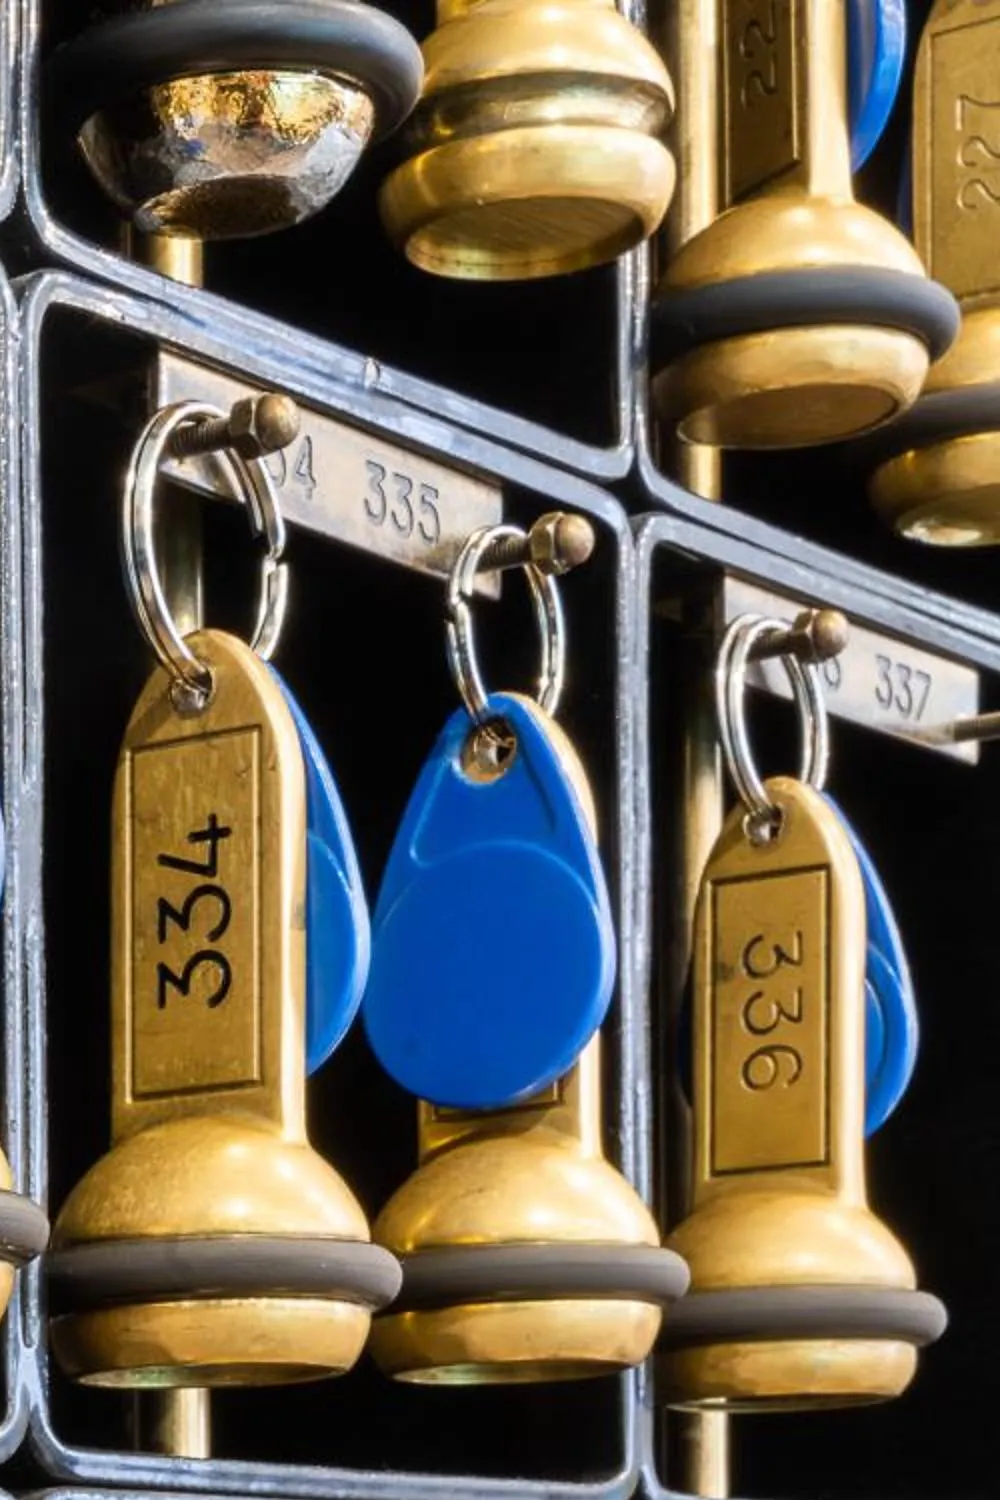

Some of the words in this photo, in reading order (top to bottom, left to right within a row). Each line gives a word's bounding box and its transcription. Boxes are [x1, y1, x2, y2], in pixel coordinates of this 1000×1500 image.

[740, 0, 778, 108] 22
[363, 459, 441, 545] 335
[875, 652, 932, 720] 337
[157, 813, 233, 1010] 334
[741, 928, 803, 1092] 336
